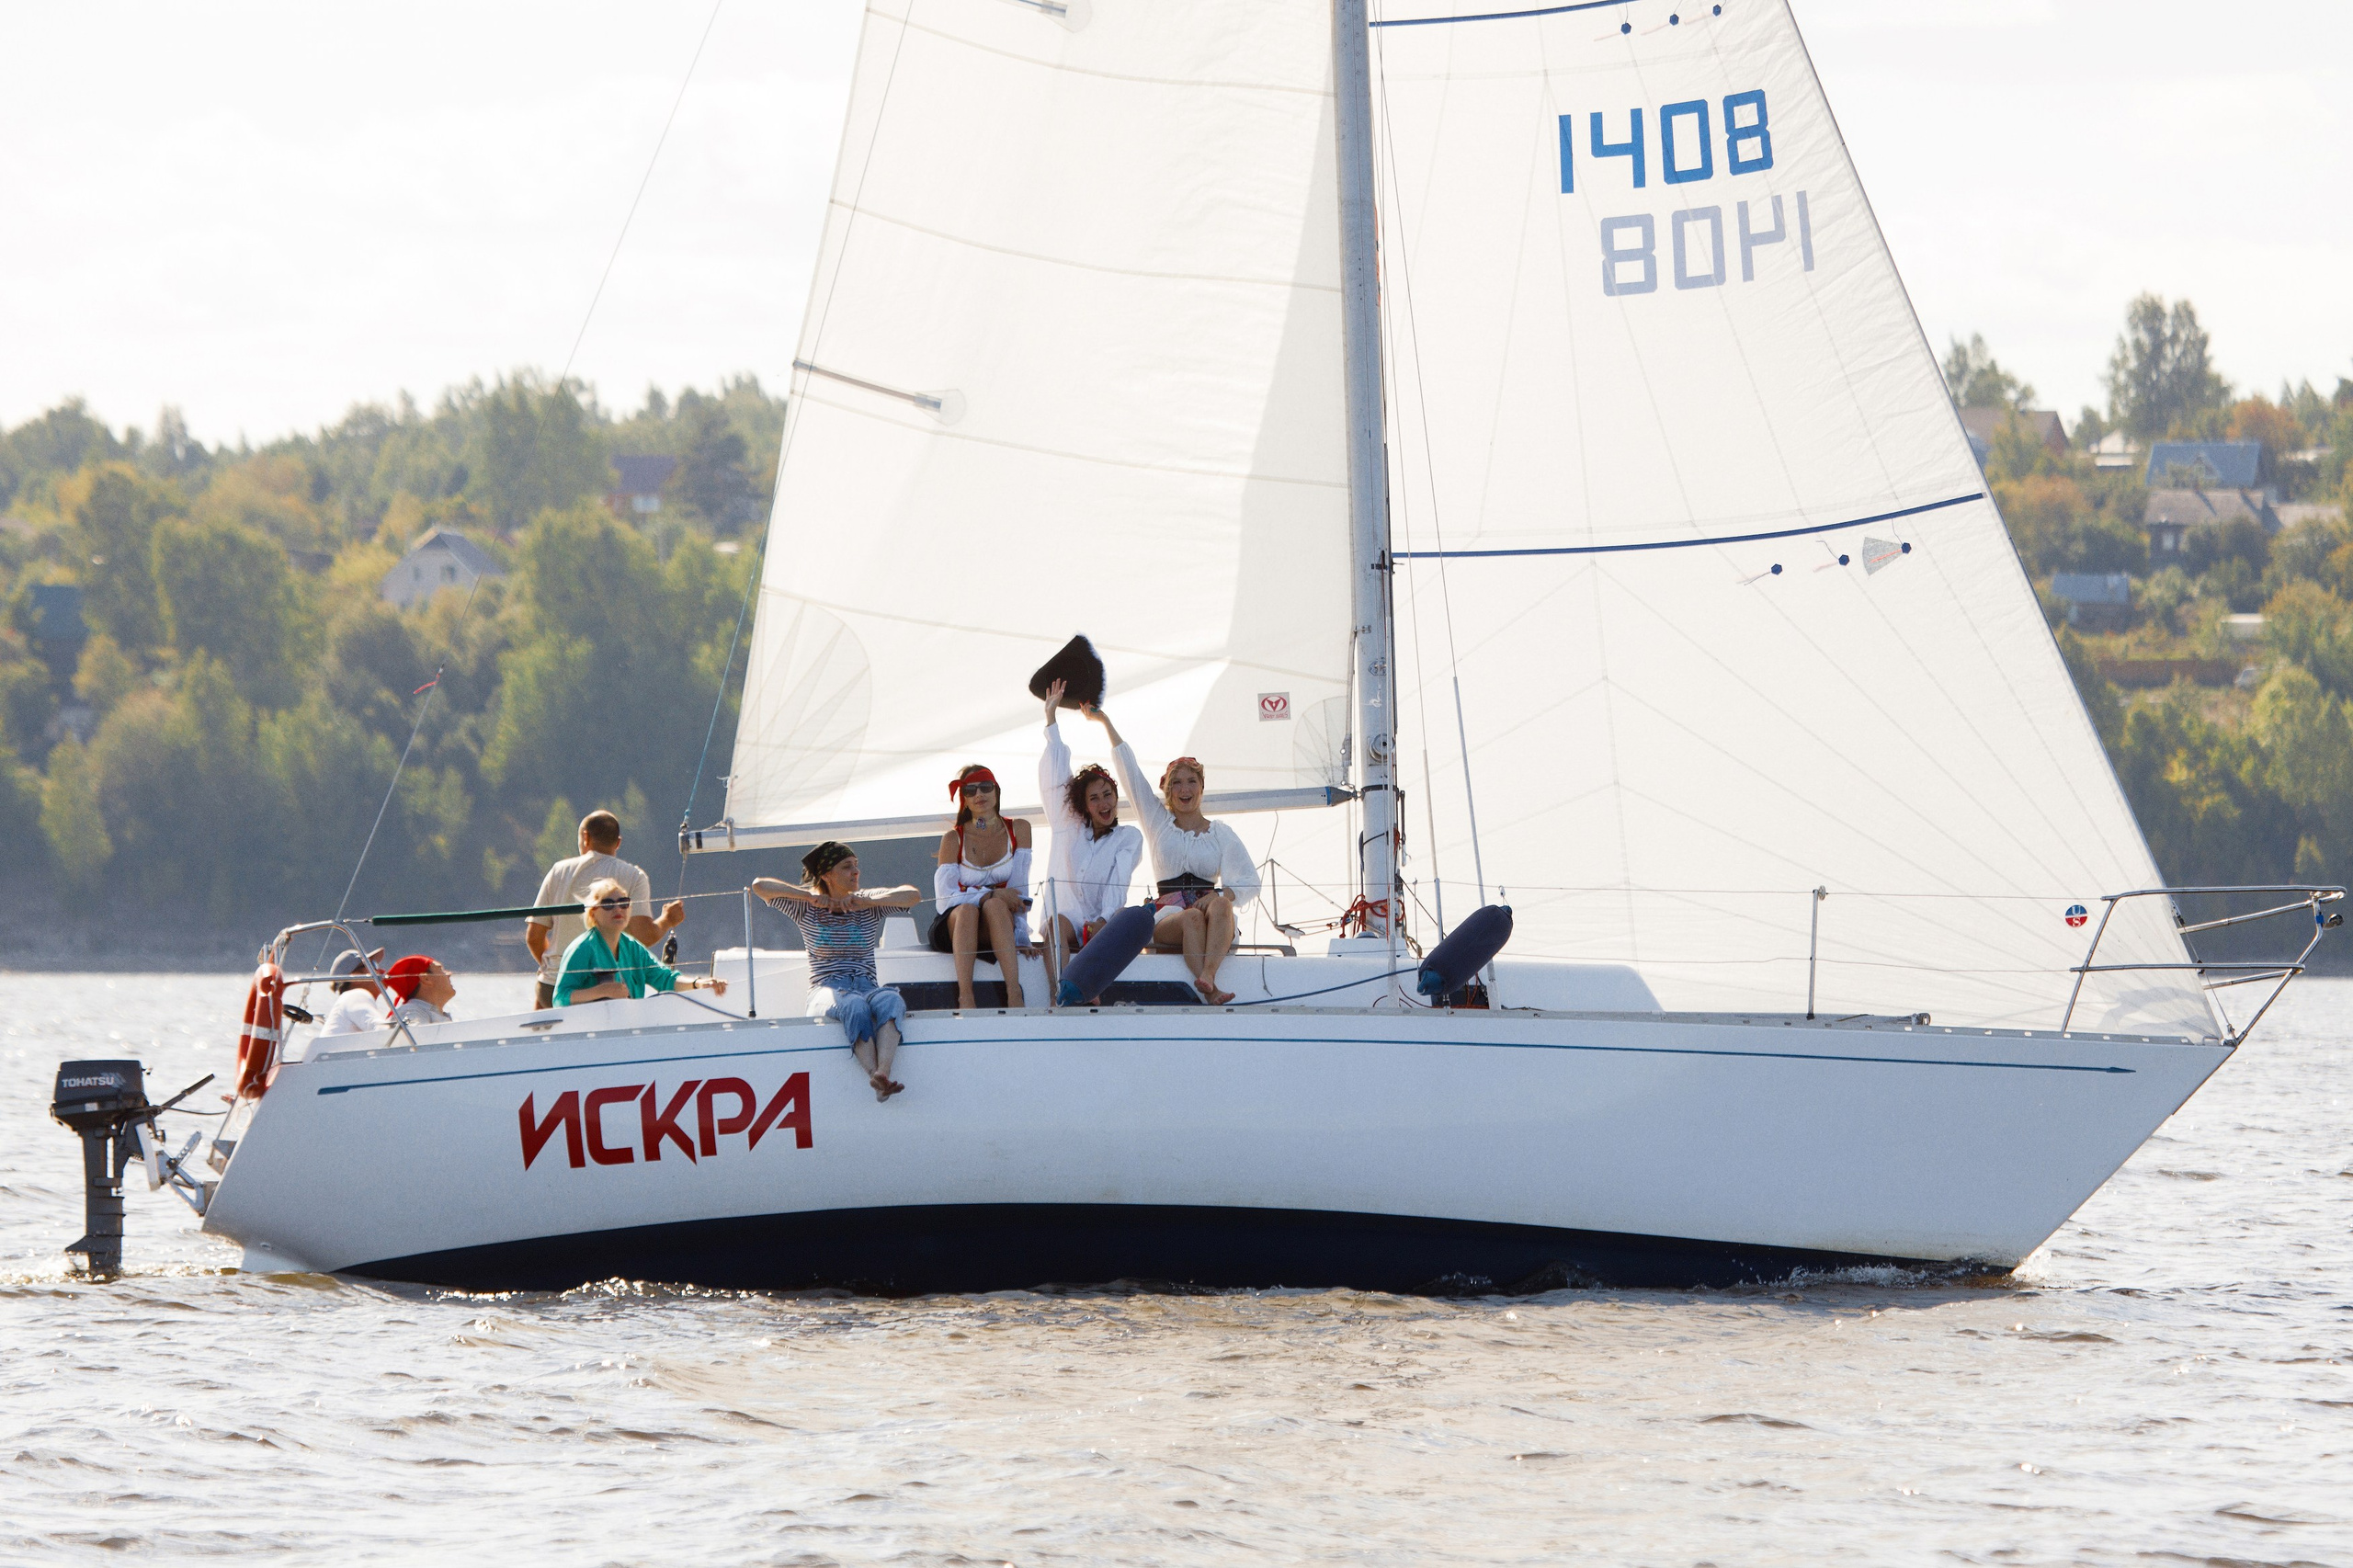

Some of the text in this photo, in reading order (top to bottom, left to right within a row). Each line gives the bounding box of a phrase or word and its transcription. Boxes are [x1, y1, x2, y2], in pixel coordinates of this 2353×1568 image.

[1558, 89, 1774, 194] 1408
[62, 1076, 115, 1088] TOHATSU
[518, 1072, 813, 1171] ИСКРА
